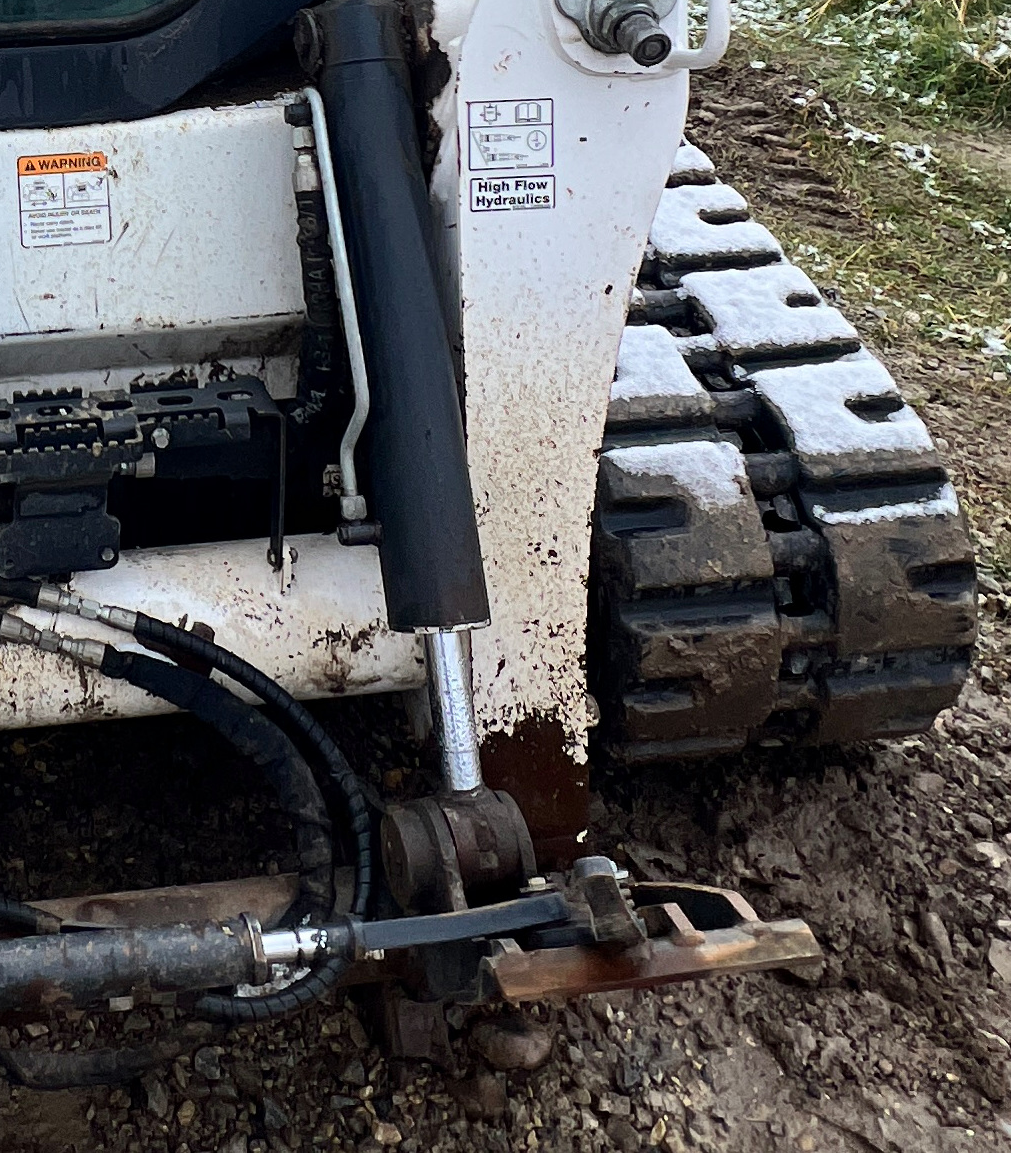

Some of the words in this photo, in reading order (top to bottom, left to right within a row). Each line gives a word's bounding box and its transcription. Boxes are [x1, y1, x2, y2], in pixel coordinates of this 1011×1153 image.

[38, 156, 102, 171] WARNING
[478, 181, 509, 194] High
[514, 180, 548, 191] Flow
[476, 193, 550, 208] Hydraulics
